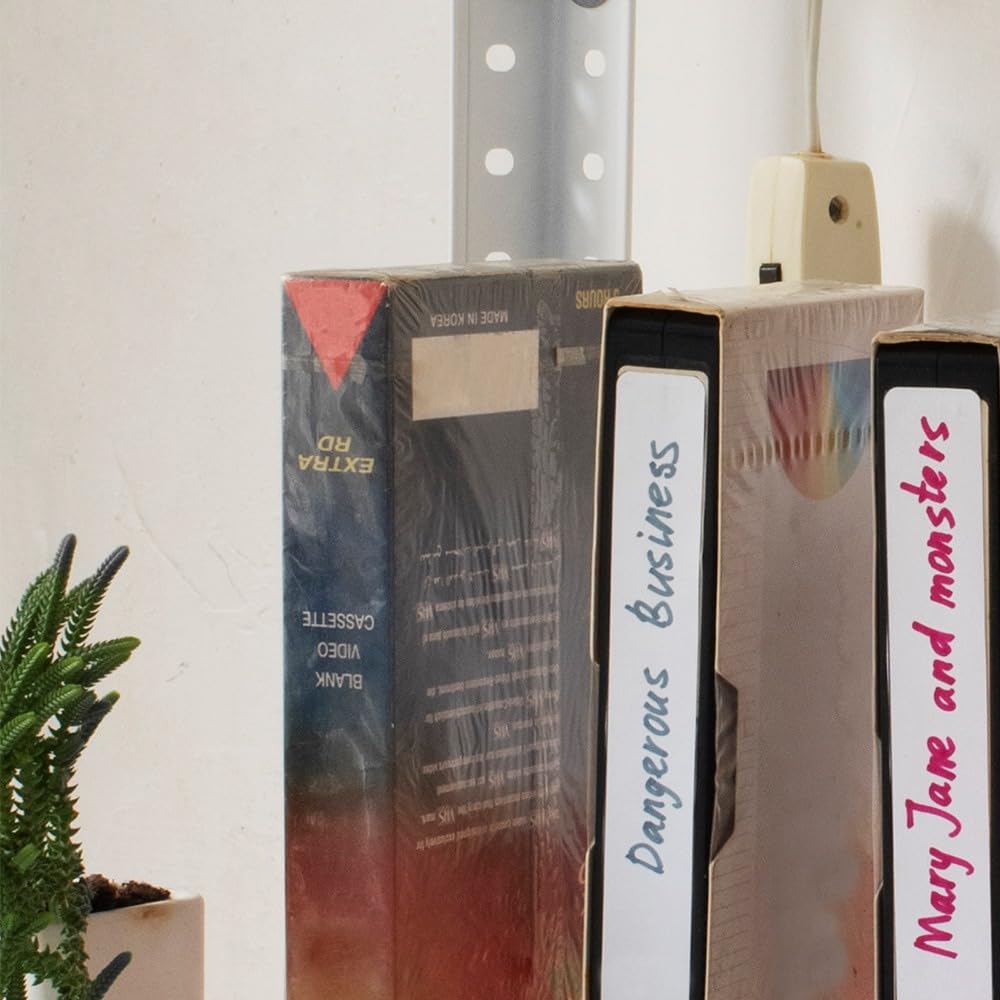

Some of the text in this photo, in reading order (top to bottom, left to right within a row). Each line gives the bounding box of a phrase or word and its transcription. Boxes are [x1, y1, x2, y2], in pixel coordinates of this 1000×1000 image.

[430, 309, 509, 328] MADE IN KOREA
[317, 434, 352, 453] RD
[297, 453, 375, 474] EXTRA
[302, 610, 375, 631] CASSETTE
[316, 641, 361, 660] VIDEO
[624, 438, 683, 876] Dangerous Business
[314, 671, 363, 690] BLANK
[899, 415, 975, 960] Mary Jane and monsters
